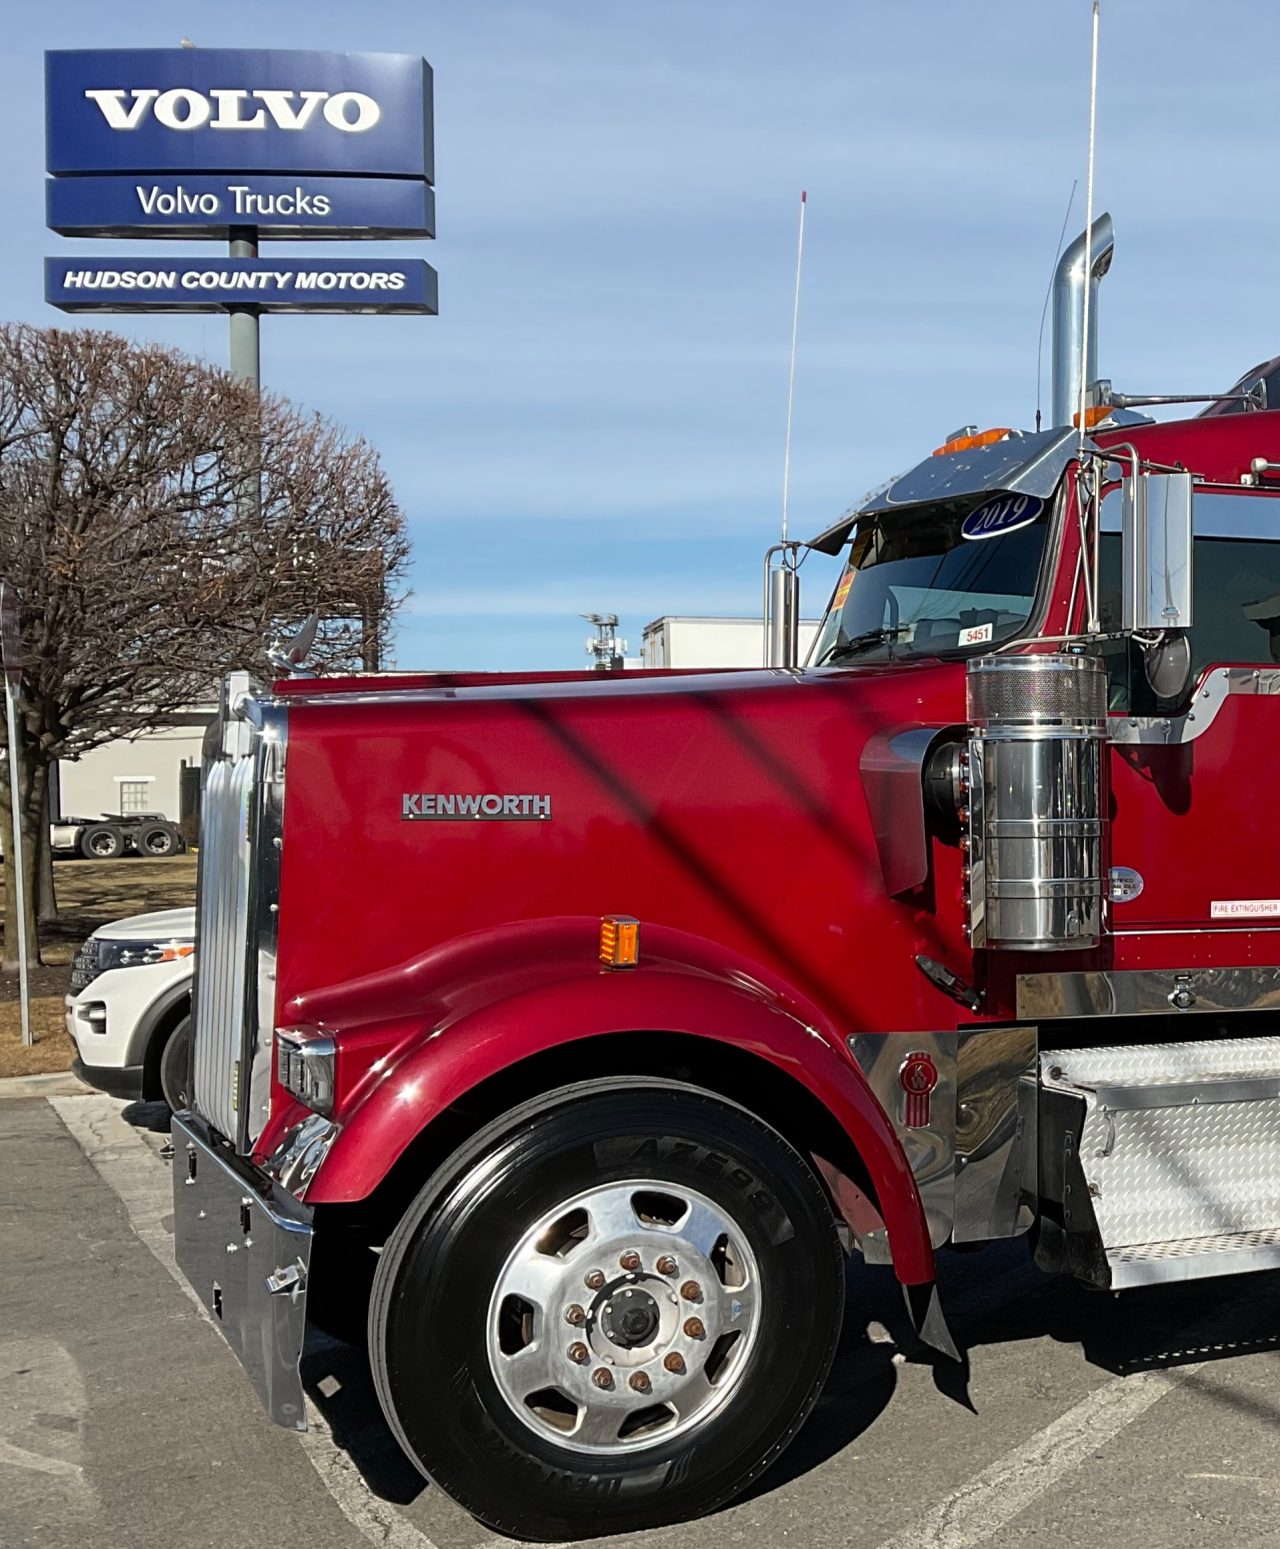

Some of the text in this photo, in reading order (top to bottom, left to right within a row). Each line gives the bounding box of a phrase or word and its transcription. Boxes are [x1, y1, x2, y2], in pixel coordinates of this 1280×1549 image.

[85, 88, 380, 132] VOLVO
[136, 186, 331, 215] Volvo Trucks
[63, 271, 406, 290] HUDSON COUNTY MOTORS
[969, 495, 1029, 535] 2019
[966, 627, 989, 643] 5451
[402, 793, 550, 815] KENWORTH
[1214, 904, 1229, 913] FIRE
[1231, 903, 1278, 913] EXTINGUISHER
